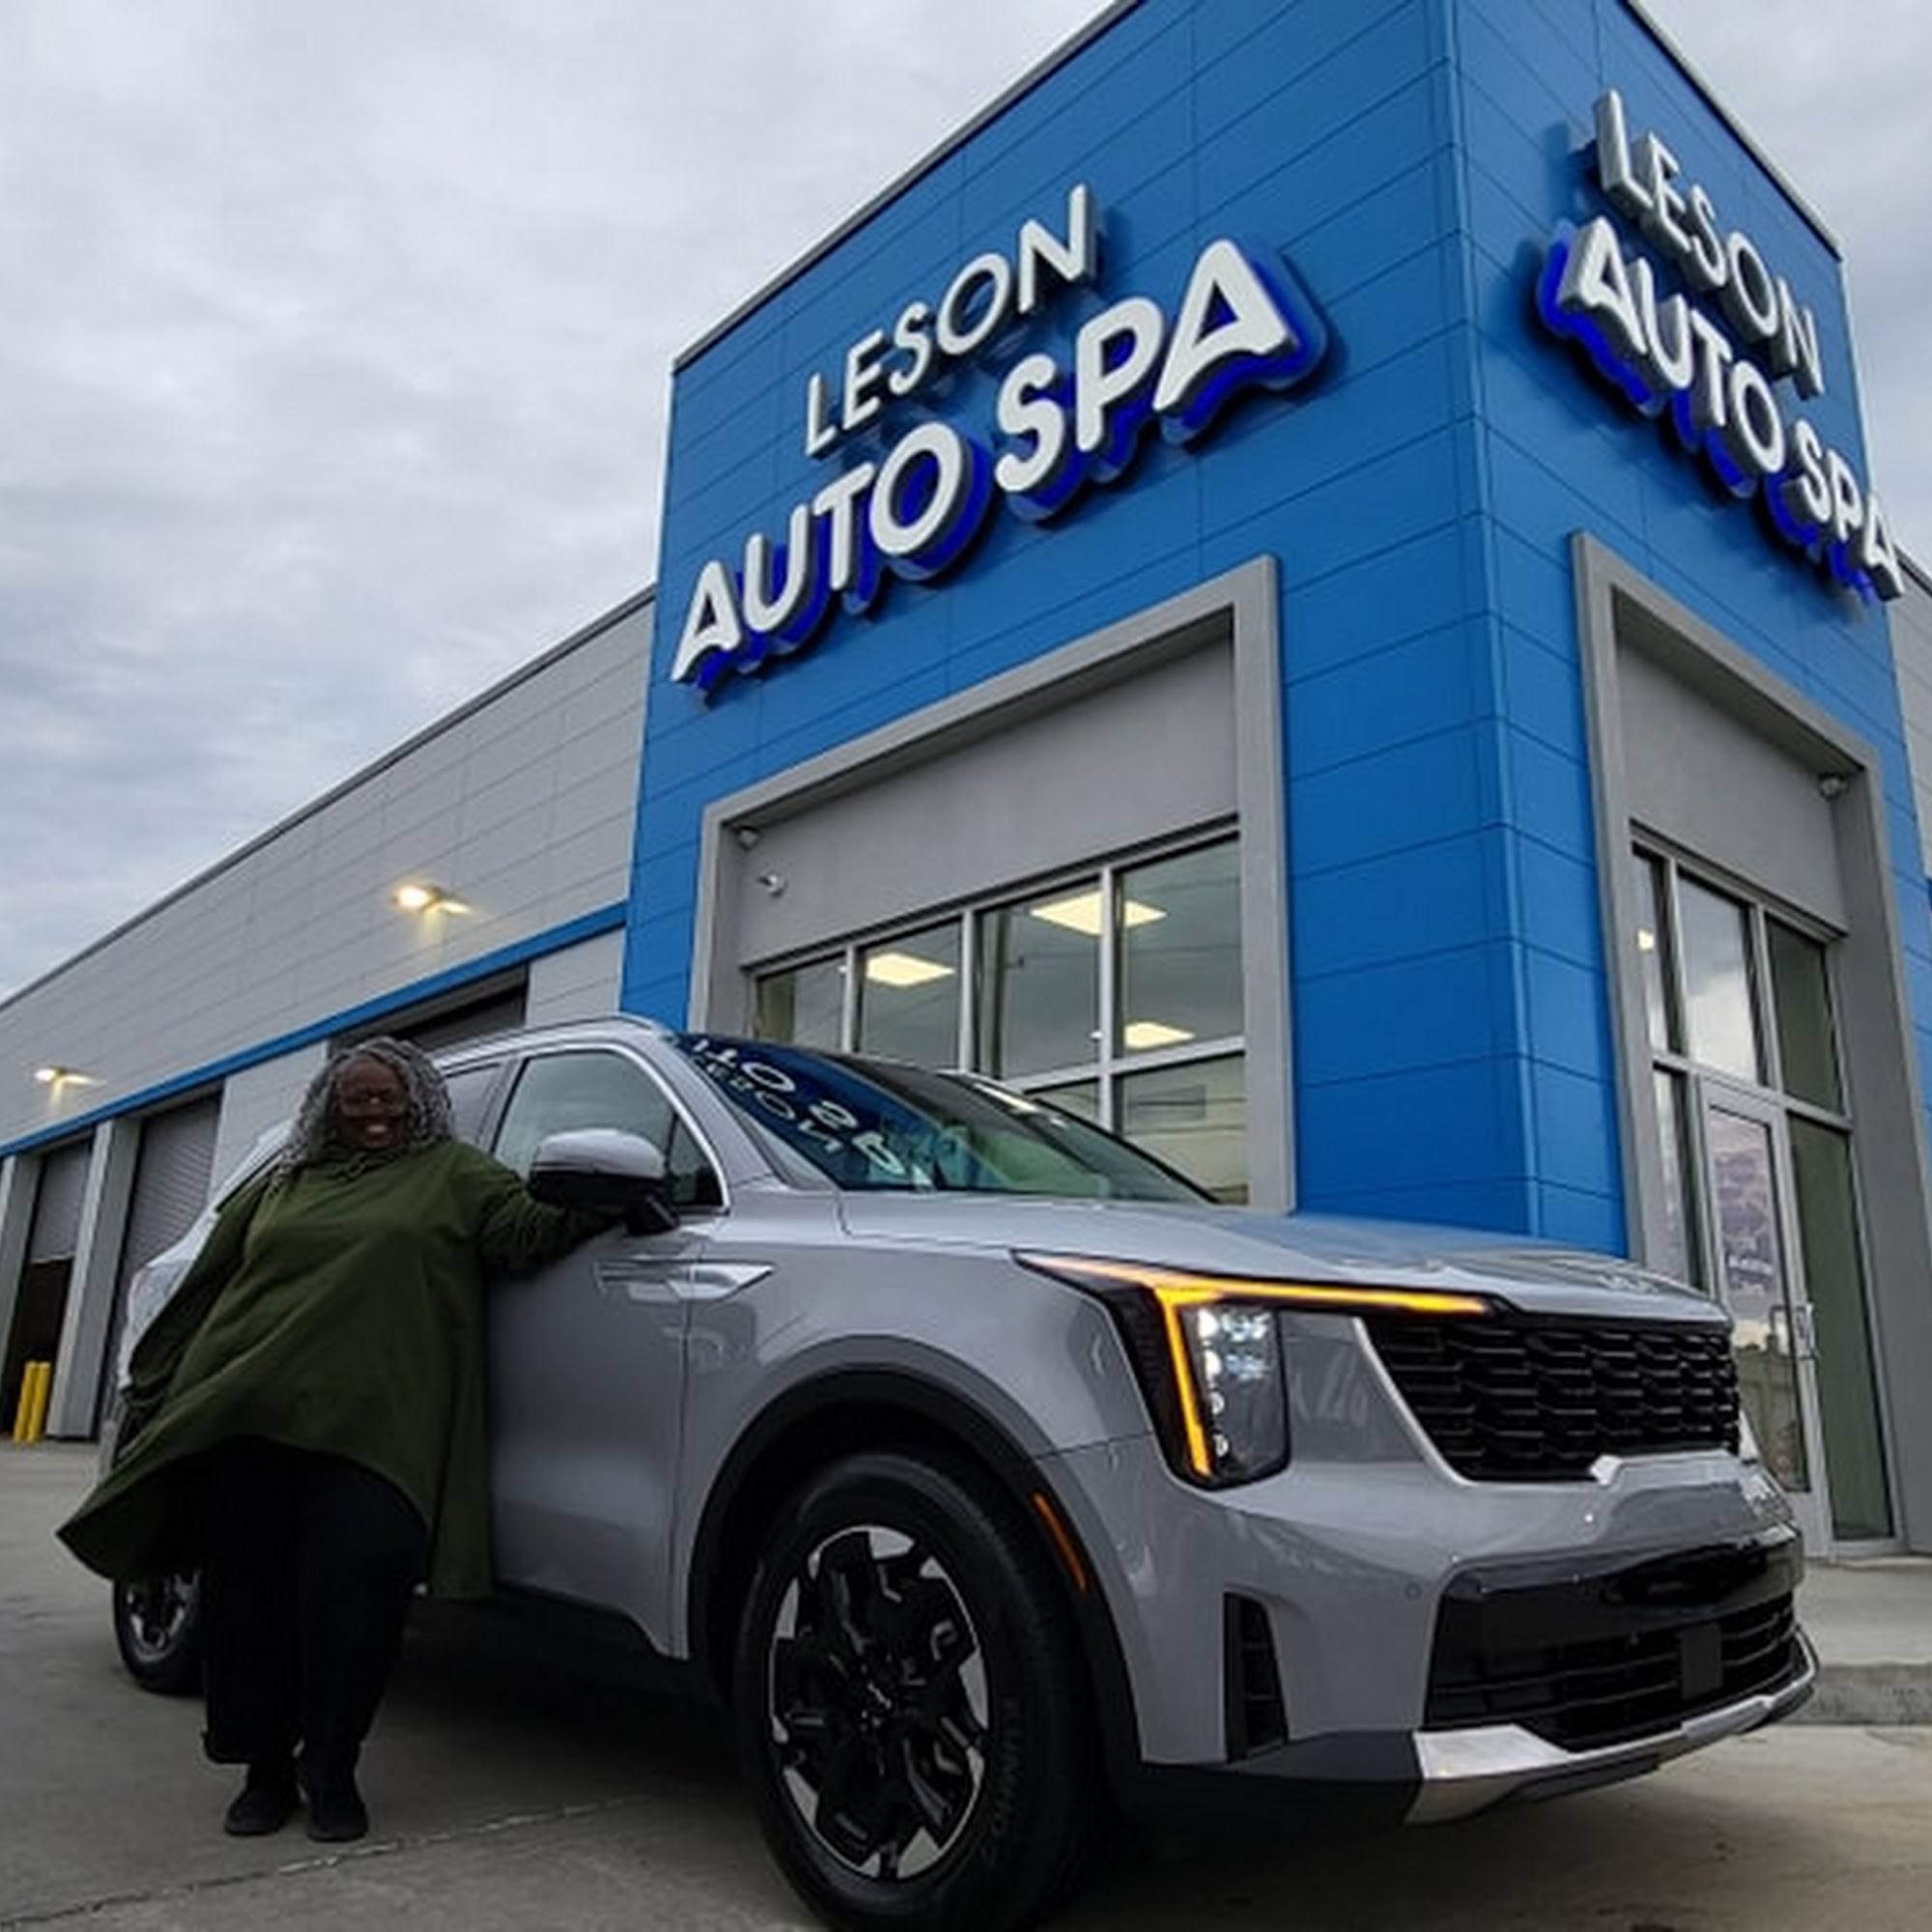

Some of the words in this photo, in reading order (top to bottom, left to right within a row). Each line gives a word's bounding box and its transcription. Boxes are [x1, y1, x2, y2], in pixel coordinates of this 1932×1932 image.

[805, 183, 1094, 457] LESON
[1557, 216, 1785, 473] AUTO
[1794, 418, 1906, 600] SPA
[1594, 87, 1824, 398] LESON
[672, 422, 968, 684] AUTO
[995, 239, 1297, 493] SPA
